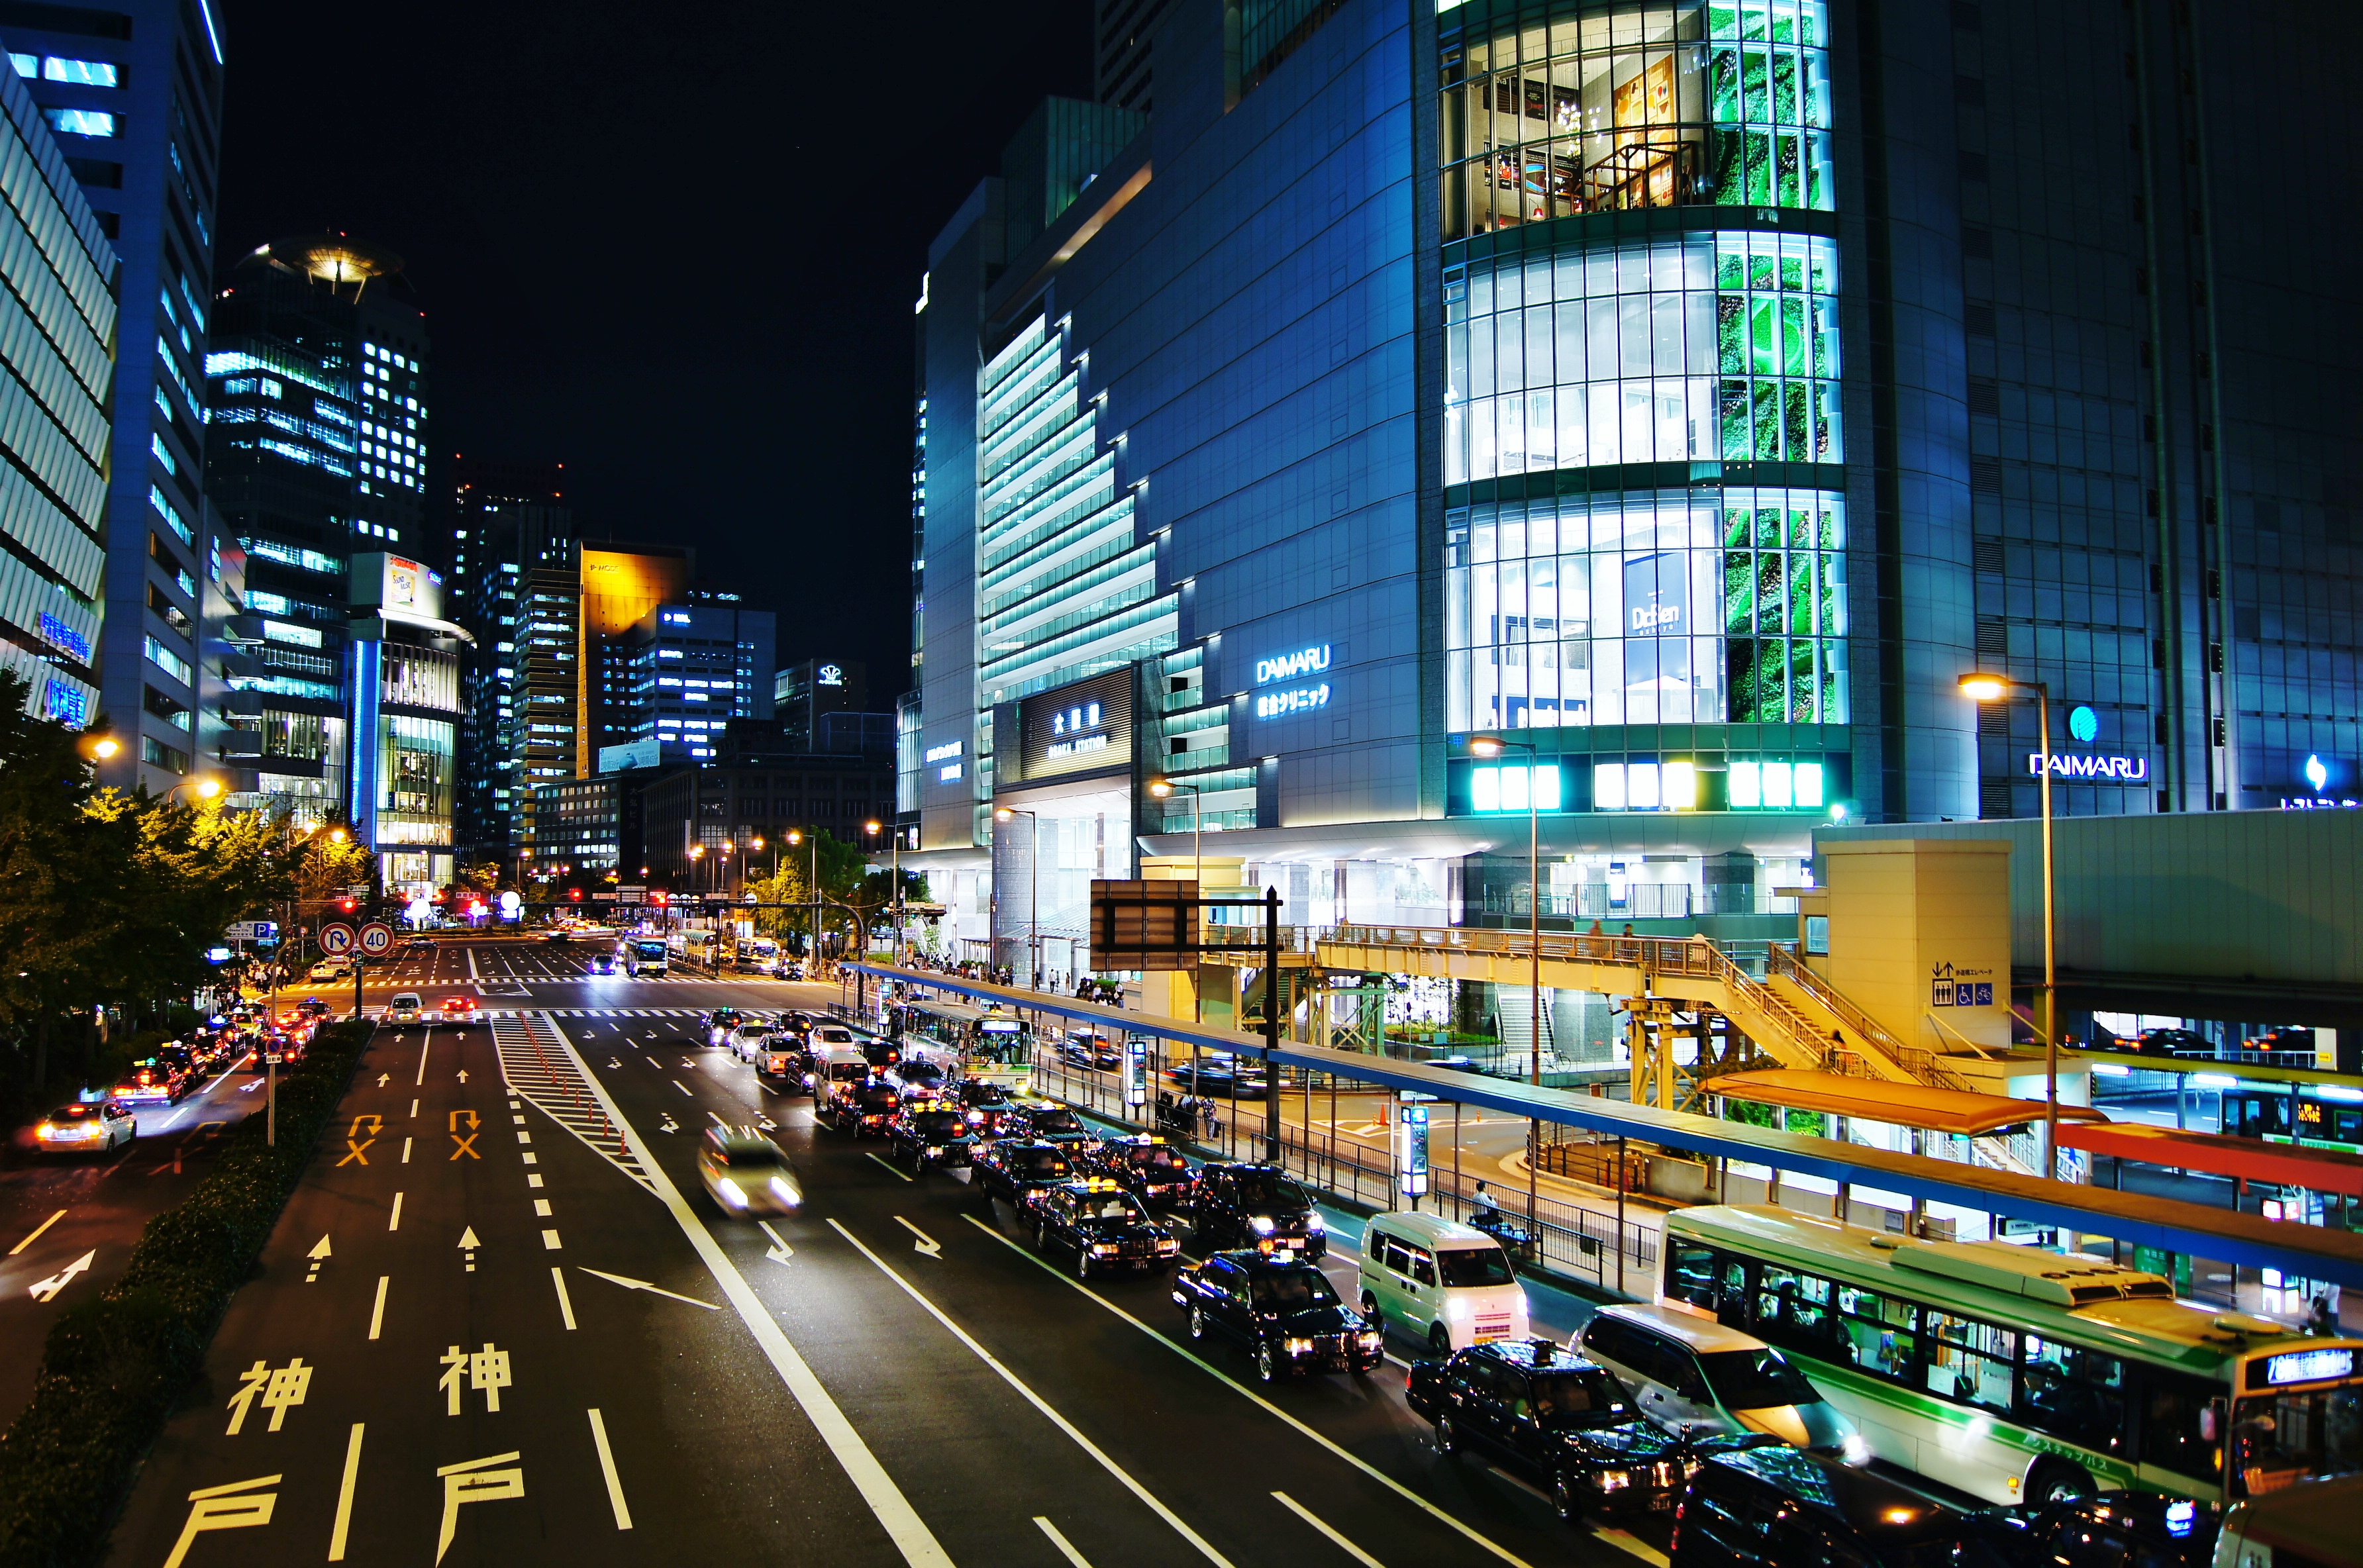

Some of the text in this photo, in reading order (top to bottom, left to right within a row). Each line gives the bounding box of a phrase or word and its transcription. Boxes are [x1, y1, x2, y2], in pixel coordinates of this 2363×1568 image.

[1257, 644, 1330, 683] DAIMARU
[1048, 735, 1107, 759] OSAKA STATION
[2029, 753, 2145, 779] DAIMARU
[258, 924, 266, 936] P
[366, 932, 385, 947] 40
[436, 1342, 525, 1567] 神戸
